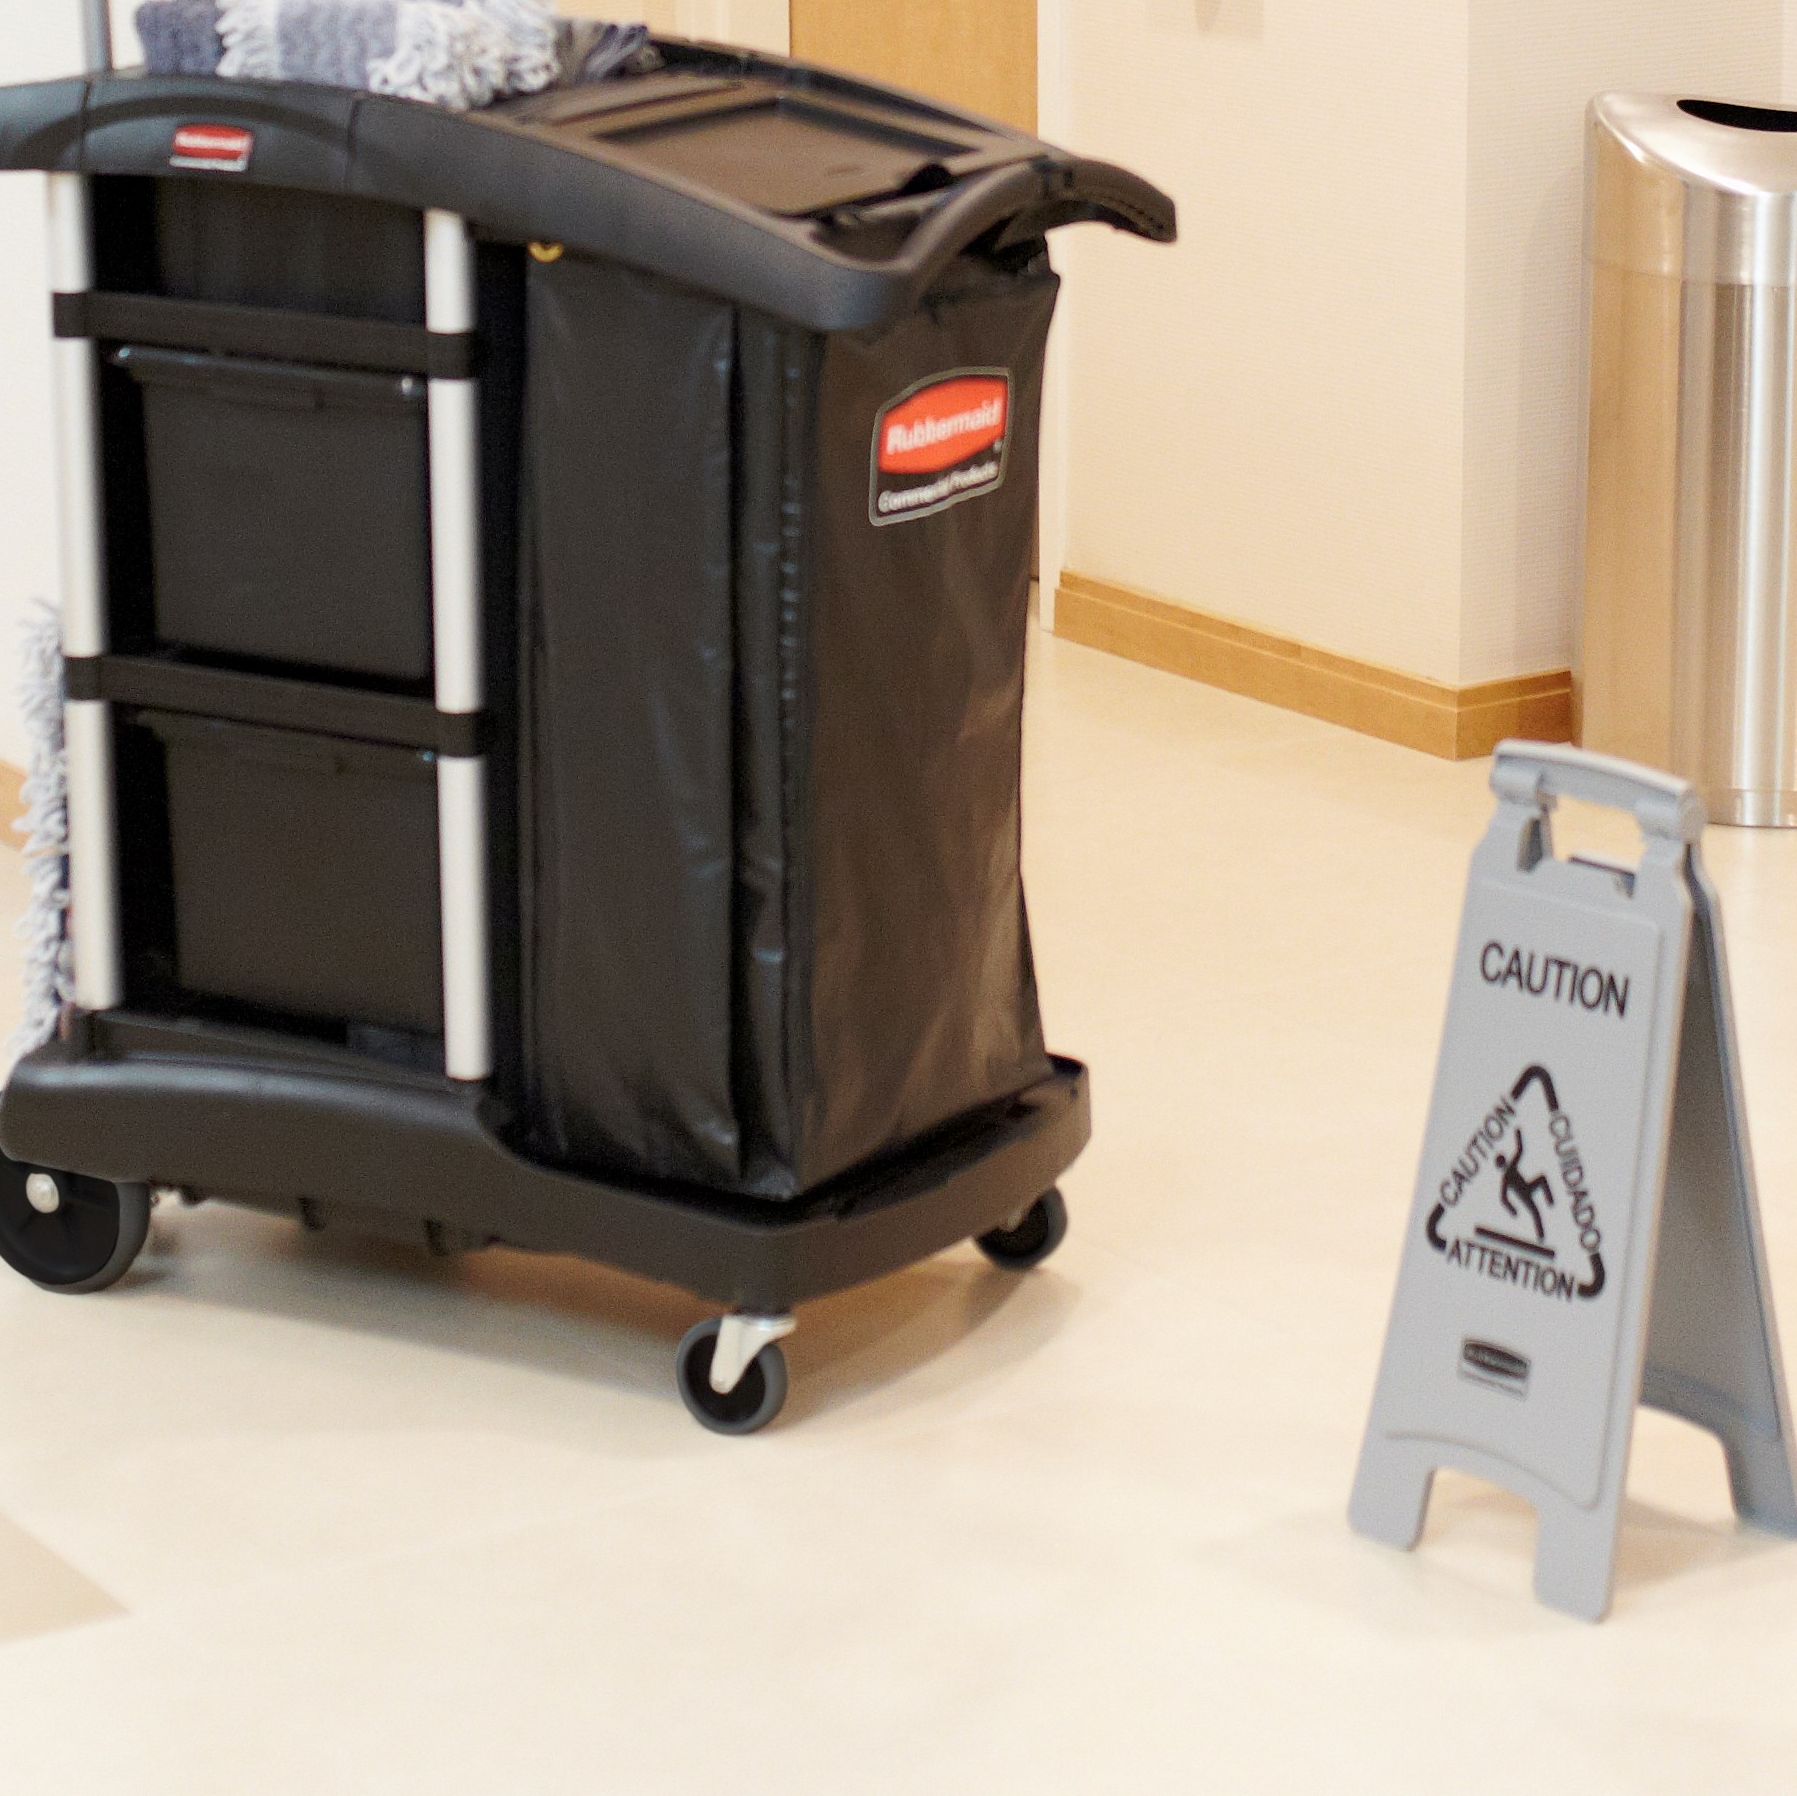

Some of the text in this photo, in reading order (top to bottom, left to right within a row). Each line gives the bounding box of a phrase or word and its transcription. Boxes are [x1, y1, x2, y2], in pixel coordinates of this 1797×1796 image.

[886, 398, 1004, 455] Rubbermaid
[1480, 940, 1629, 1018] CAUTION
[1440, 1096, 1516, 1205] CAUTION
[1550, 1115, 1601, 1252] CUIDADO
[1447, 1238, 1574, 1301] ATTENTION
